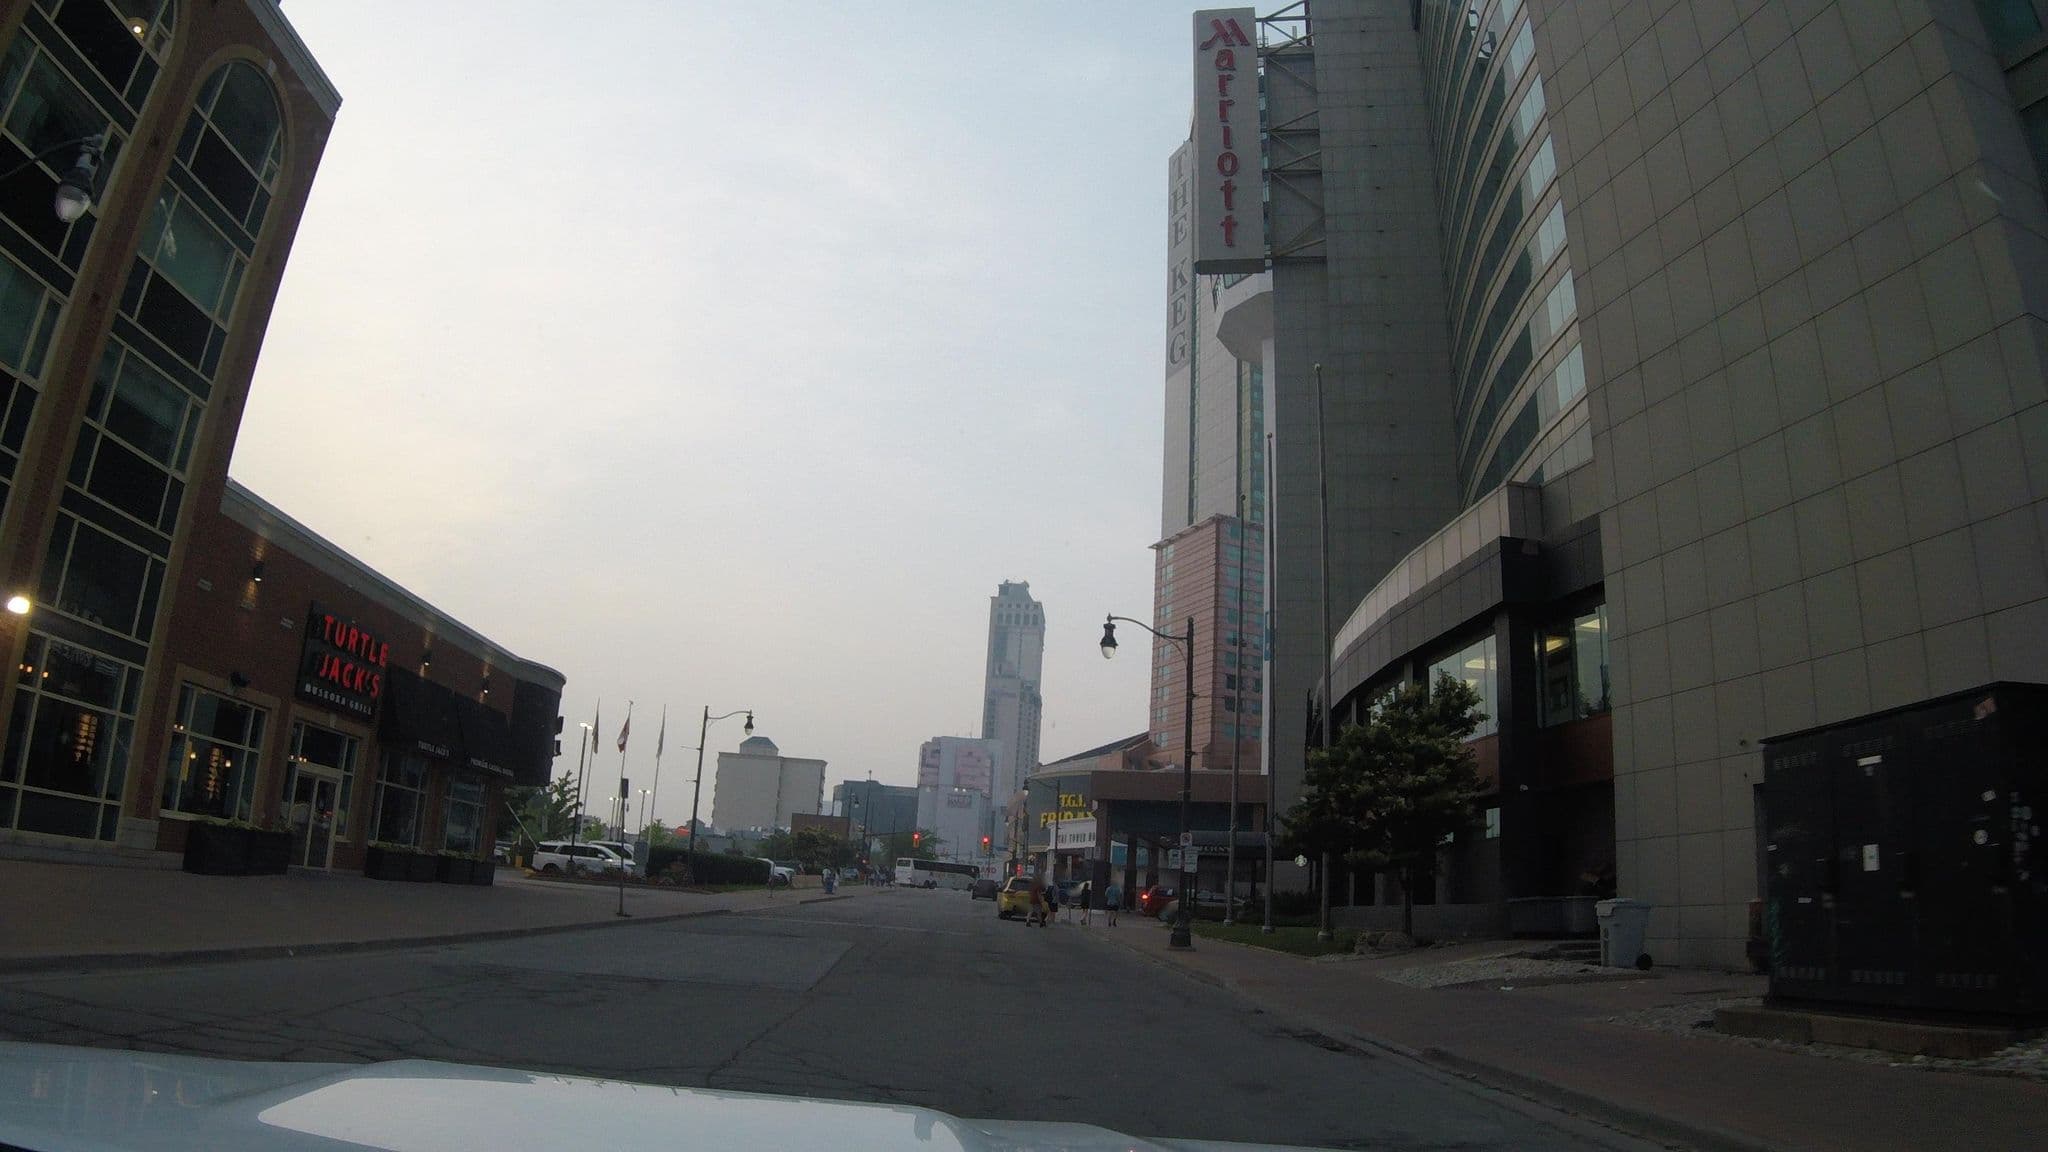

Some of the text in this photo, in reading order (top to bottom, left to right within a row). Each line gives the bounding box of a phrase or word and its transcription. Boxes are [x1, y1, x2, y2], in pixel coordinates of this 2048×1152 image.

[1200, 17, 1251, 249] Marriott
[1169, 151, 1188, 366] THE KEG
[323, 614, 390, 669] TURTLE
[304, 682, 373, 716] MUSKOKA GRILL
[319, 653, 381, 700] JACK'S
